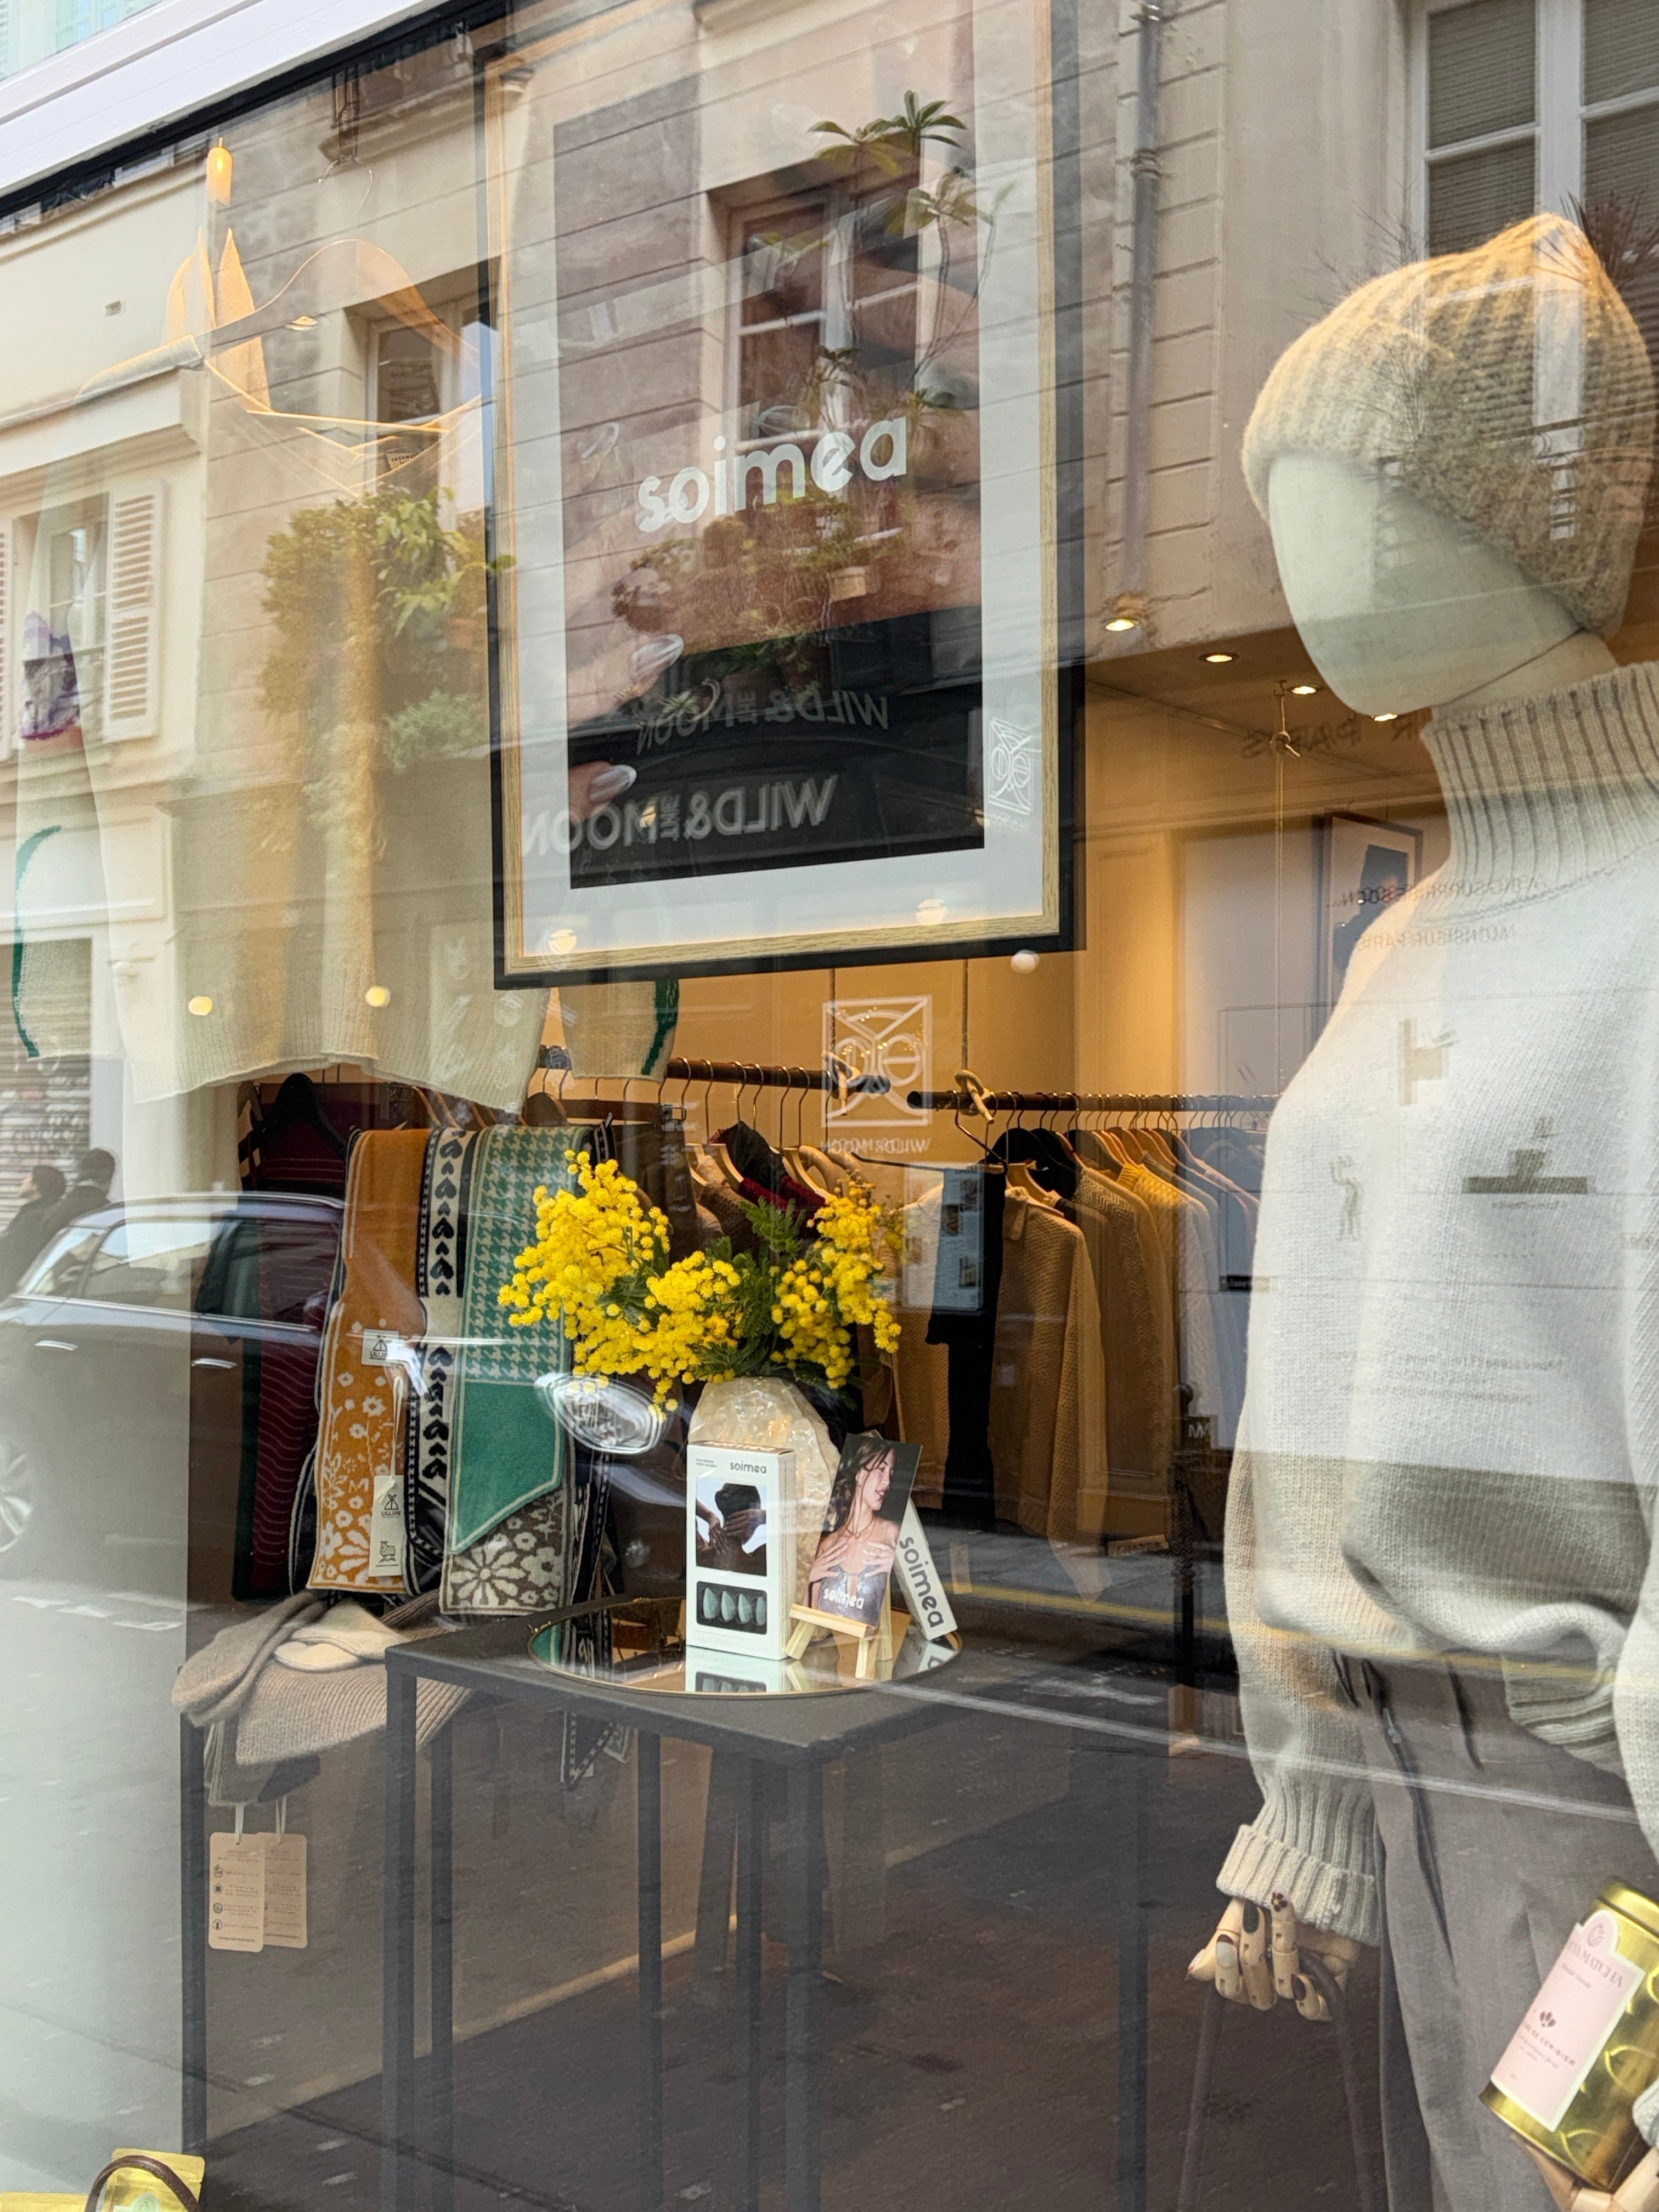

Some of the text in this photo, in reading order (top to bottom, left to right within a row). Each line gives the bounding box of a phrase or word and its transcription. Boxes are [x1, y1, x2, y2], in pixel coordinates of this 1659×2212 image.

[638, 416, 907, 533] soimea
[730, 1460, 767, 1475] soimea
[822, 1587, 865, 1610] soimea
[899, 1536, 944, 1628] soimea
